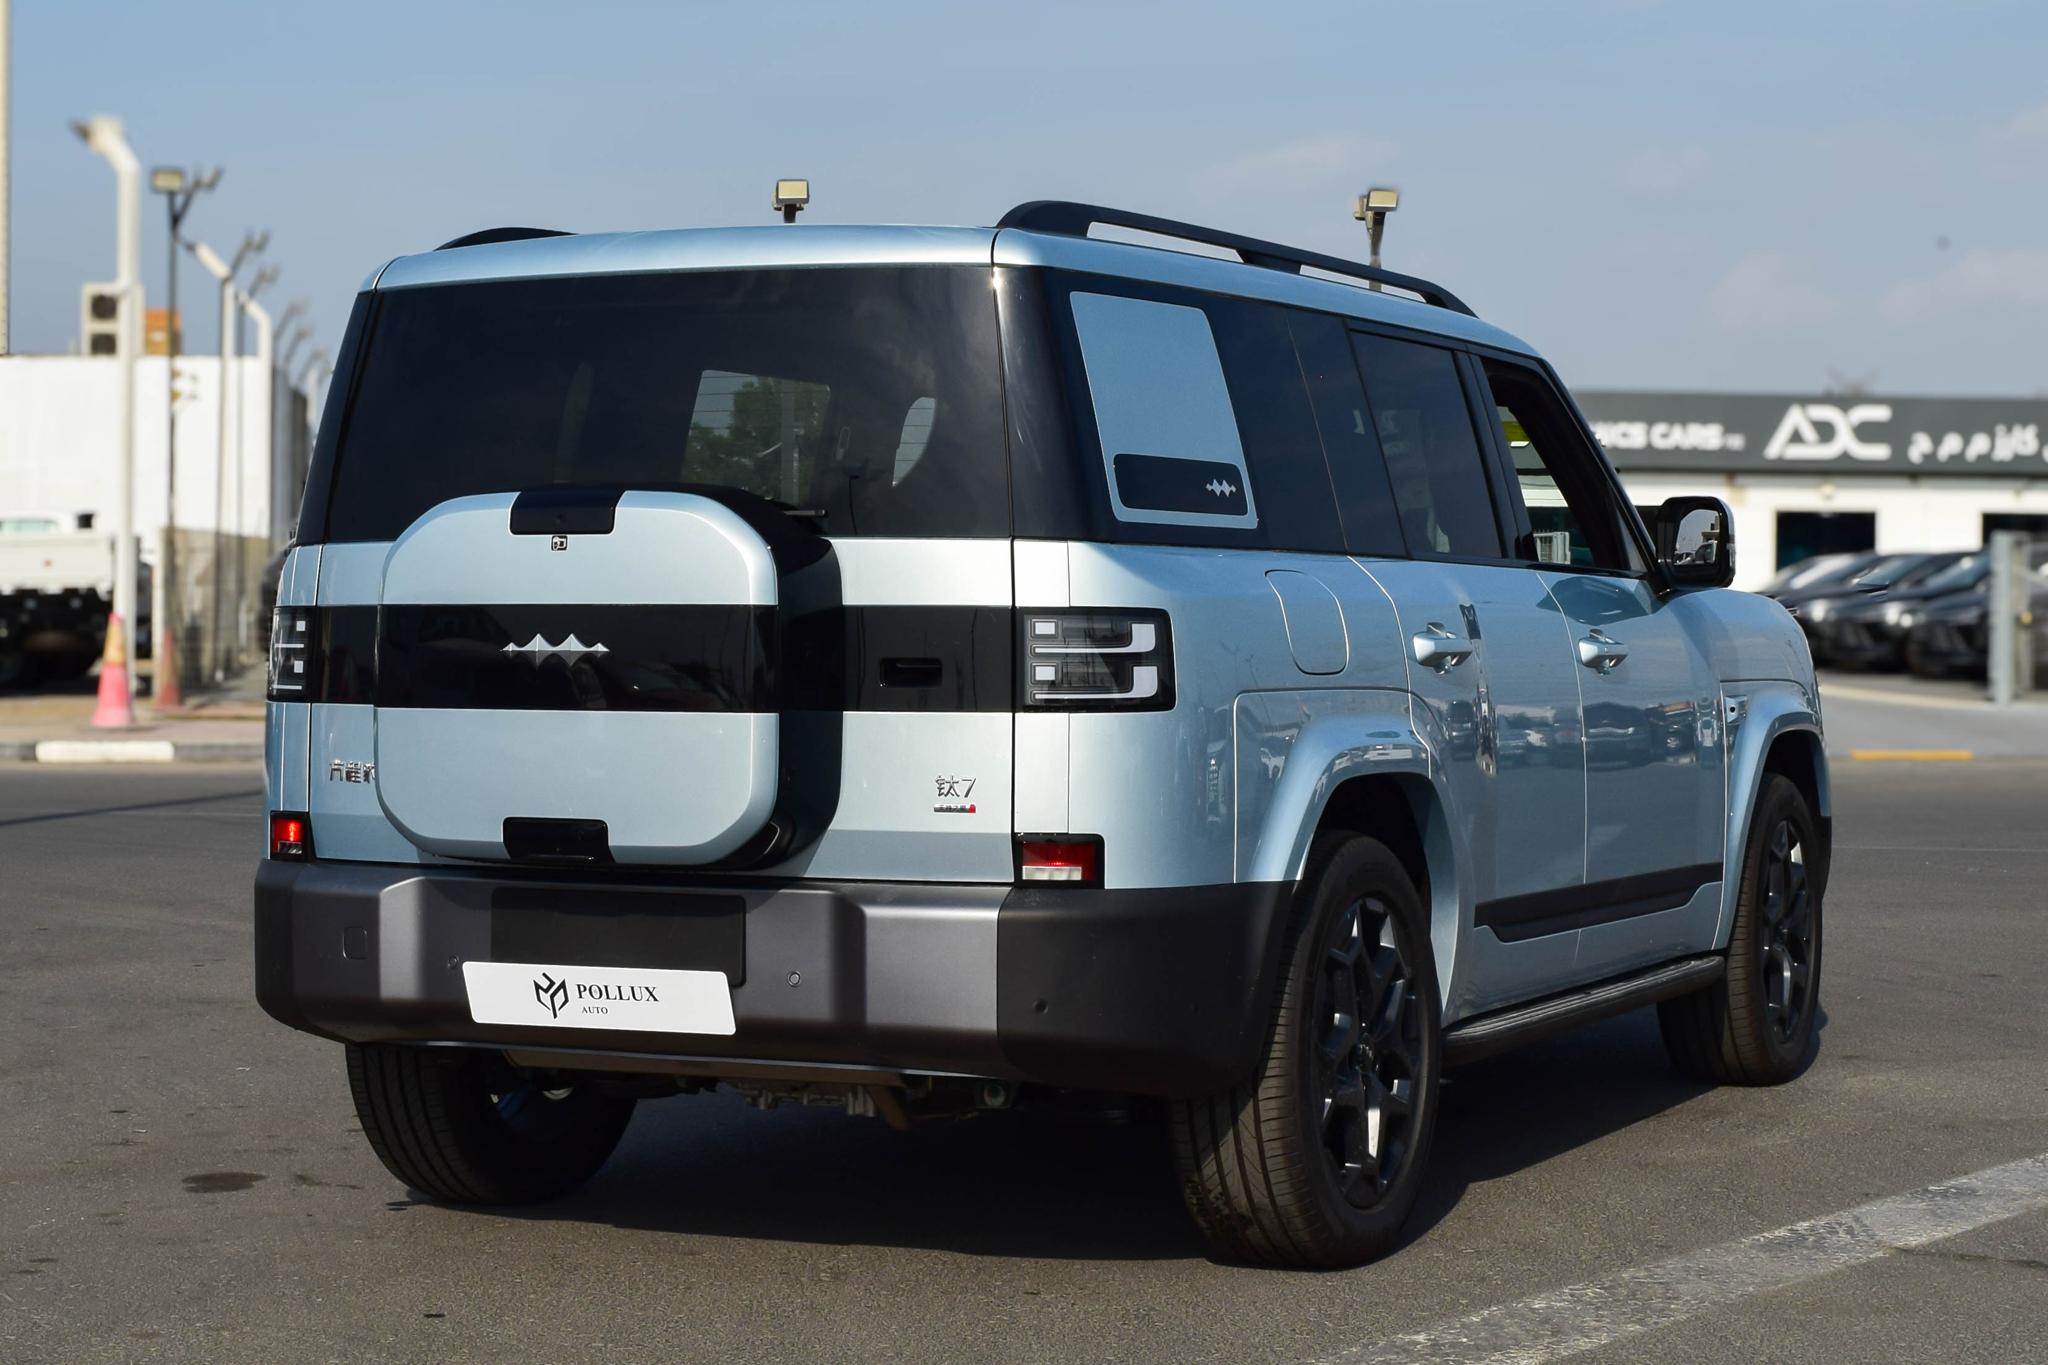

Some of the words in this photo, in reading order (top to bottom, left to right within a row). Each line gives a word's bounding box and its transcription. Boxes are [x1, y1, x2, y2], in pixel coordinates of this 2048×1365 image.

[1650, 421, 1725, 451] CARS
[1763, 404, 1893, 461] ADC
[935, 775, 976, 798] 钛7
[576, 983, 659, 1002] POLLUX
[581, 1006, 608, 1015] AUTO
